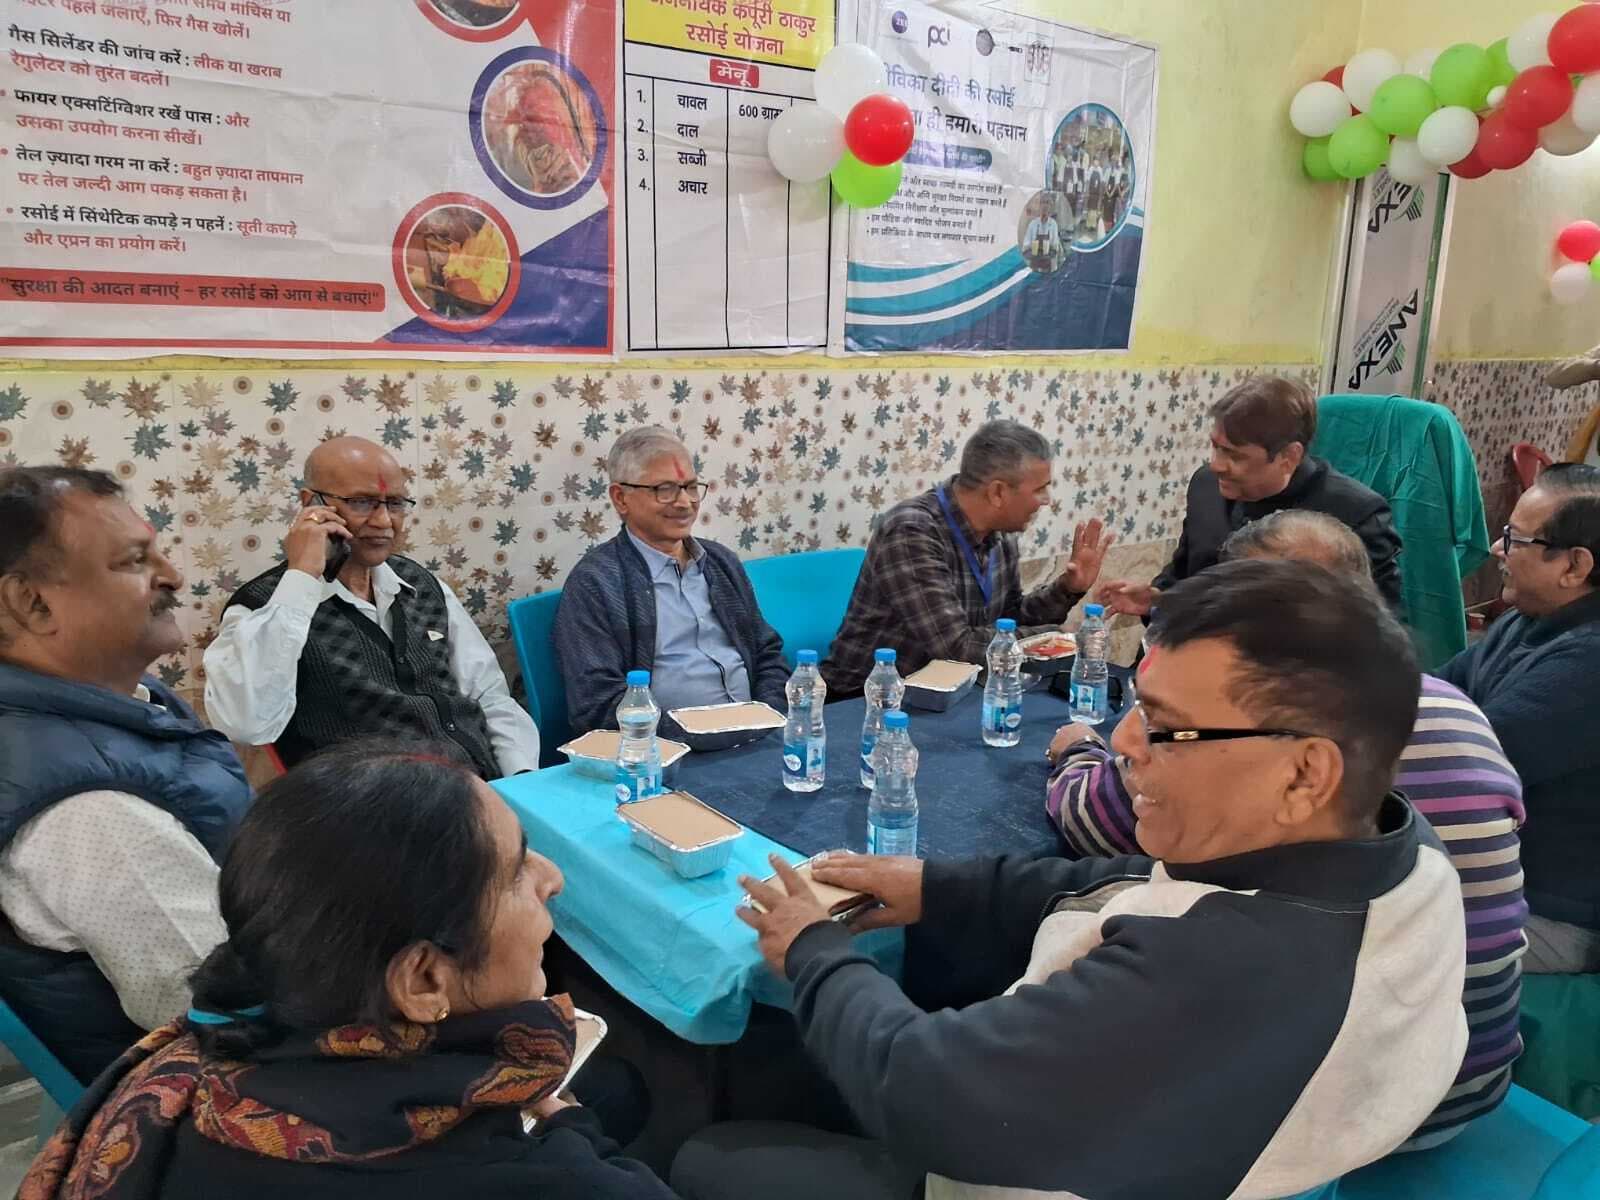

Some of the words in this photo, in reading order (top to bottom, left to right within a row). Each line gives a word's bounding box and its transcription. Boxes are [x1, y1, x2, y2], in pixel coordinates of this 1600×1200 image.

[101, 4, 151, 27] जलाएँ,
[155, 9, 182, 28] फिर
[186, 14, 209, 32] गैस
[212, 19, 251, 39] खोलें।
[230, 1, 273, 20] माचिस
[276, 10, 291, 23] या
[732, 0, 773, 31] कर्पूरी
[777, 10, 817, 39] ठाकुर
[8, 23, 36, 44] गैस
[40, 28, 95, 54] सिलेंडर
[98, 38, 119, 57] की
[124, 44, 155, 62] जांच
[159, 48, 182, 66] करें
[193, 53, 225, 71] लीक
[228, 61, 243, 74] या
[246, 63, 283, 80] खराब
[685, 20, 729, 49] रसोई
[732, 27, 785, 56] योजना
[9, 48, 66, 76] रेगुलेटर
[69, 57, 91, 78] को
[94, 63, 127, 83] तुरंत
[129, 68, 171, 88] बदलें।
[717, 63, 752, 87] मेनू
[14, 88, 57, 107] फायर
[61, 92, 155, 119] एक्सटिंग्विशर
[158, 103, 182, 121] रखें
[185, 109, 213, 125] पास
[224, 112, 251, 129] और
[636, 89, 647, 104] 1.
[676, 94, 708, 111] चावल
[964, 79, 982, 103] की
[985, 84, 1017, 111] रसोई
[738, 104, 759, 119] 600
[15, 113, 64, 133] उसका
[68, 119, 119, 139] उपयोग
[122, 125, 161, 142] करना
[163, 129, 204, 147] सीखें।
[636, 119, 649, 134] 2.
[676, 123, 699, 139] दाल
[986, 121, 1028, 142] पहचान
[15, 144, 42, 163] तेल
[46, 149, 91, 168] ज़्यादा
[93, 155, 125, 171] गरम
[128, 158, 145, 173] ना
[148, 157, 171, 175] करें
[182, 161, 213, 182] बहुत
[255, 169, 305, 186] तापमान
[636, 148, 649, 163] 3.
[676, 148, 708, 168] सब्जी
[18, 170, 39, 187] पर
[42, 170, 69, 189] तेल
[71, 174, 113, 193] जल्दी
[115, 179, 147, 195] आग
[150, 181, 186, 200] पकड़
[187, 186, 229, 201] सकता
[231, 186, 248, 203] है।
[638, 177, 651, 192] 4.
[678, 179, 709, 195] अचार
[1367, 182, 1412, 233] EXA
[20, 204, 60, 223] रसोई
[62, 205, 76, 222] में
[79, 206, 140, 227] सिंथेटिक
[142, 211, 180, 231] कपड़े
[181, 216, 193, 230] न
[195, 213, 227, 232] पहनें
[235, 217, 263, 237] सूती
[265, 218, 299, 239] कपड़े
[23, 228, 54, 247] और
[57, 233, 91, 250] एप्रन
[94, 235, 115, 250] का
[117, 234, 157, 252] प्रयोग
[158, 236, 187, 253] करें।
[62, 276, 86, 295] की
[92, 280, 135, 297] आदत
[138, 279, 180, 299] बनाएं
[196, 285, 217, 301] हर
[220, 282, 258, 302] रसोई
[259, 283, 281, 302] को
[282, 287, 313, 303] आग
[315, 285, 329, 303] से
[1348, 288, 1419, 390] ANEXA
